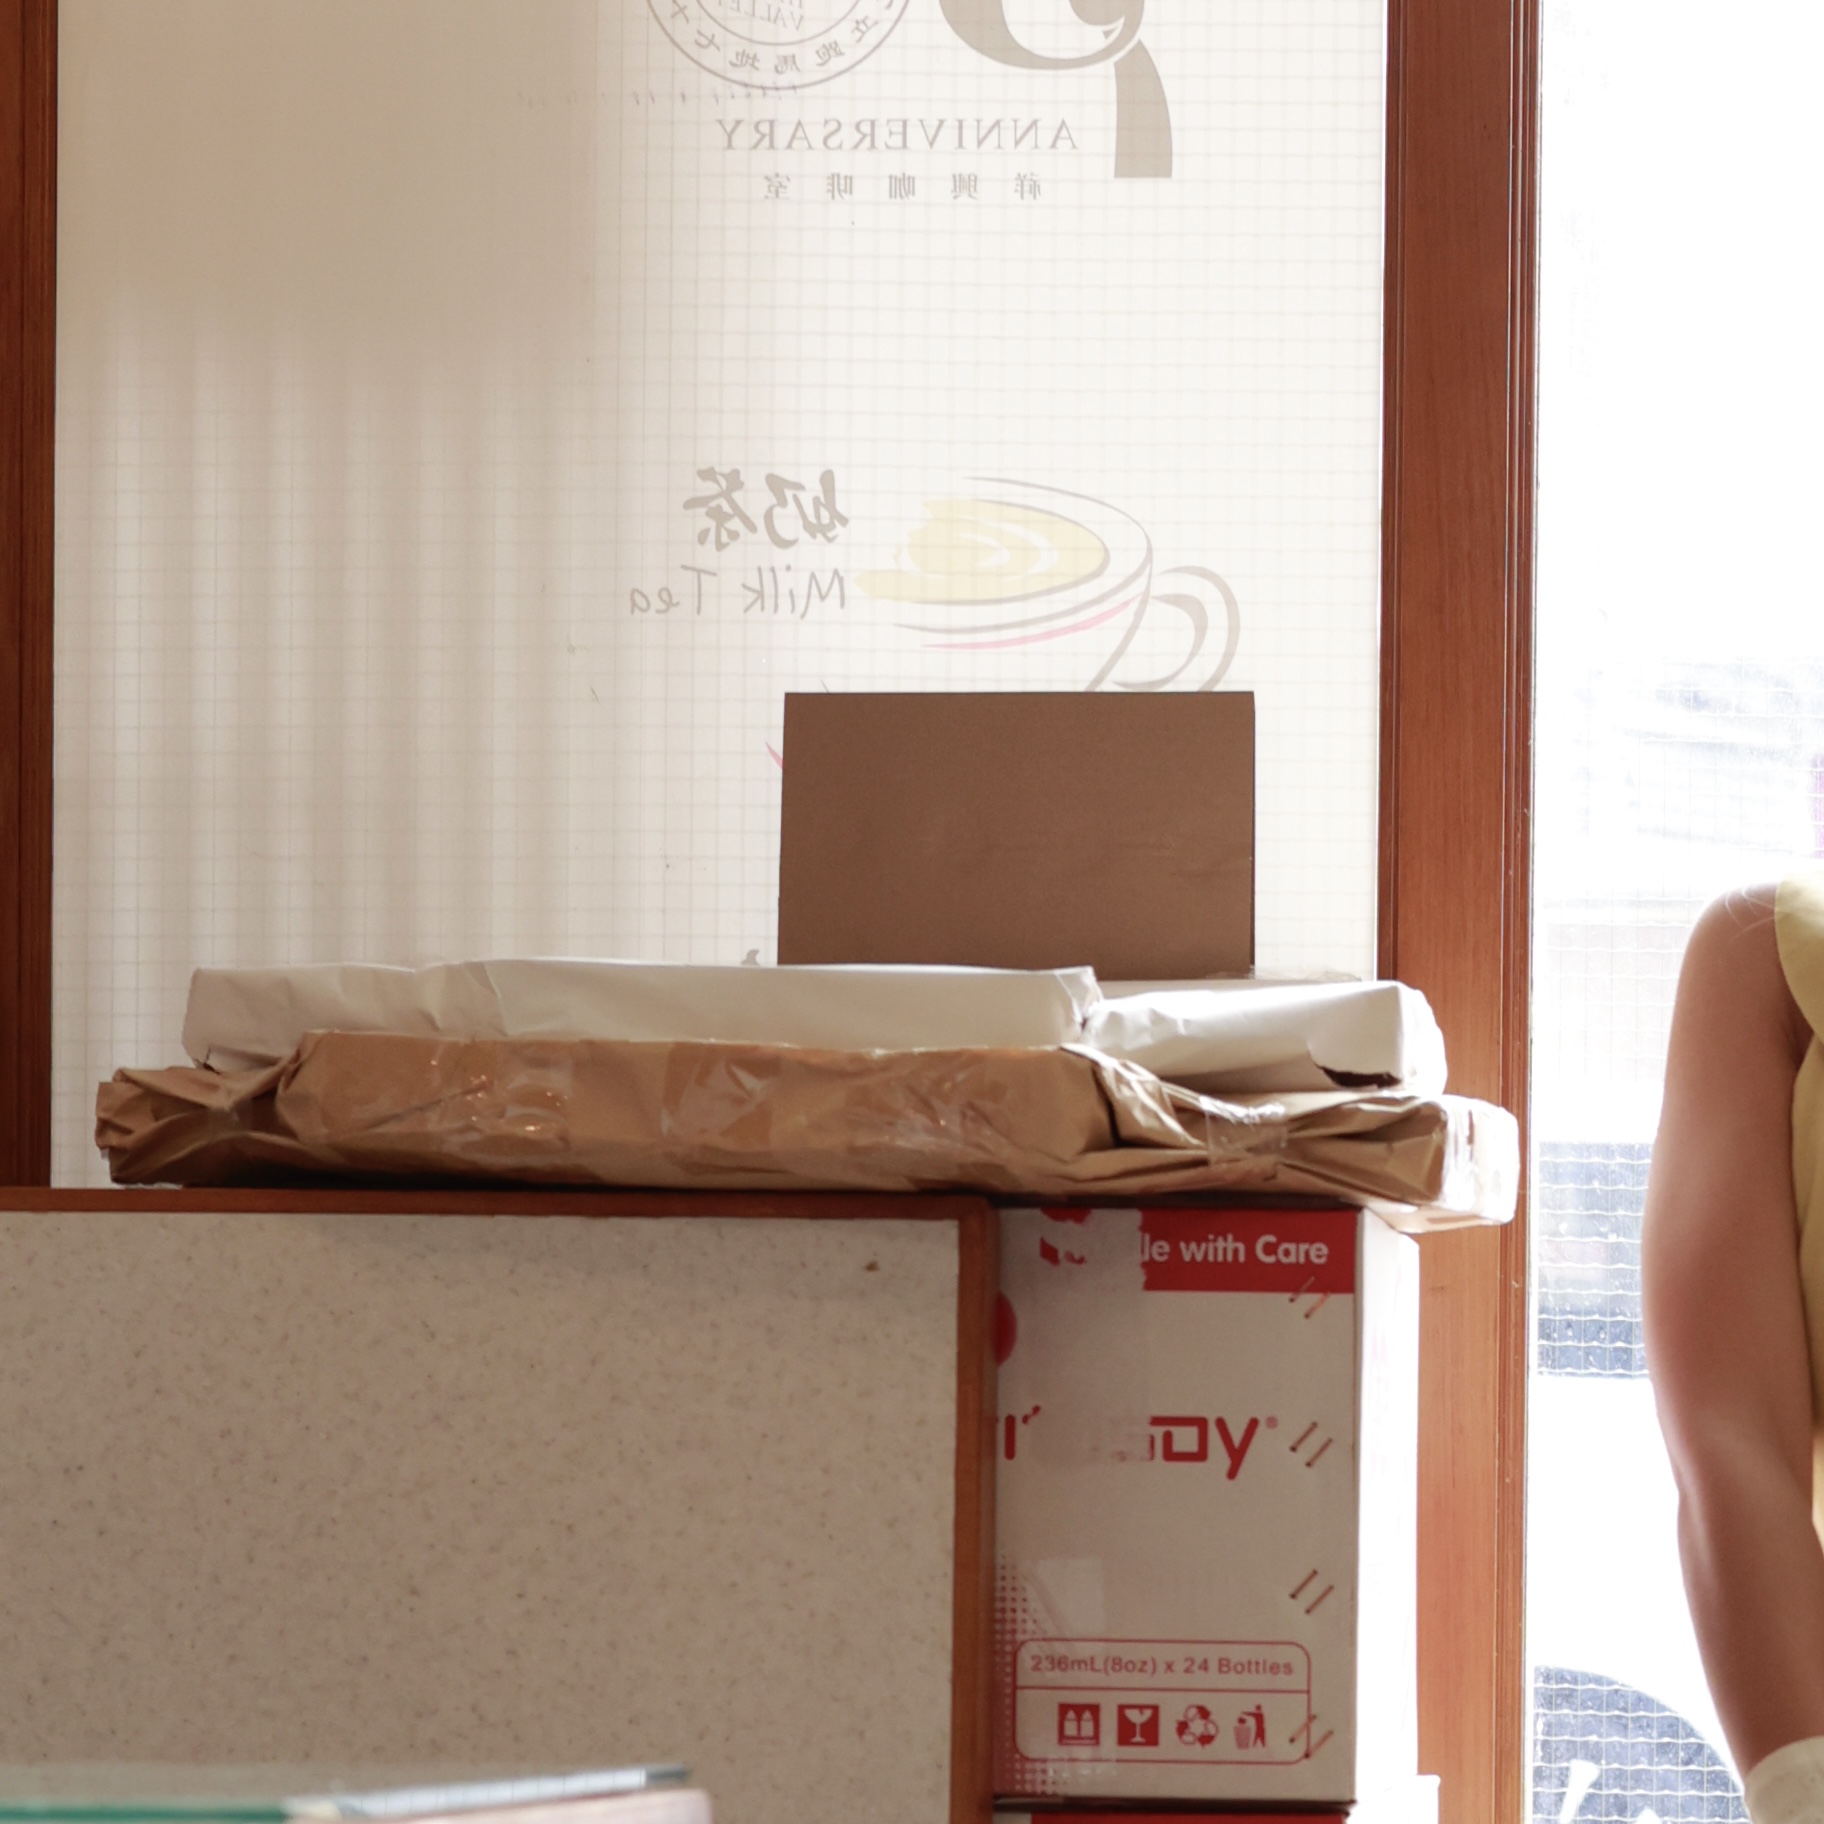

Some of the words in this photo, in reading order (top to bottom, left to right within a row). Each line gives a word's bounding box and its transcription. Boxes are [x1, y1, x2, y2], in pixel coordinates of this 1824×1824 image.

[1179, 1234, 1245, 1262] with
[1255, 1235, 1329, 1264] Care
[1029, 1655, 1157, 1675] 236mL(8oz)
[1182, 1657, 1209, 1674] 24
[1217, 1657, 1293, 1676] Bottles
